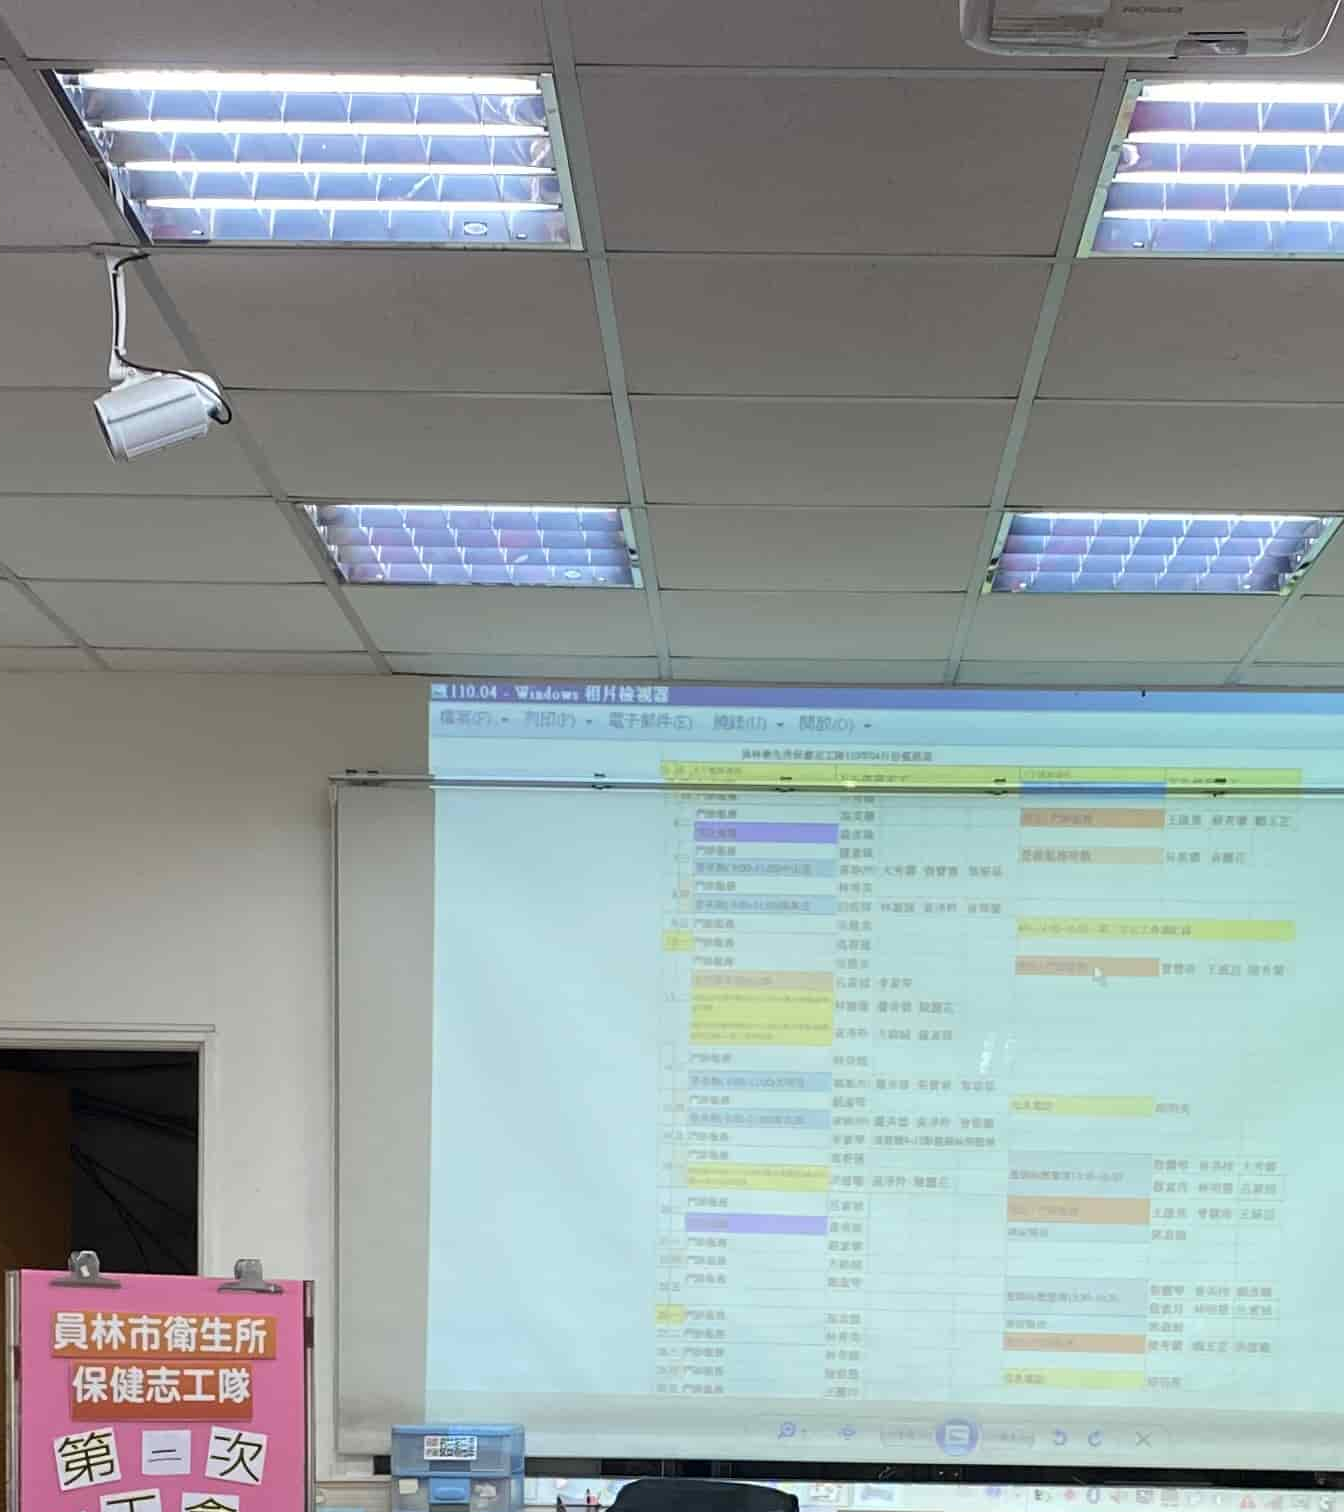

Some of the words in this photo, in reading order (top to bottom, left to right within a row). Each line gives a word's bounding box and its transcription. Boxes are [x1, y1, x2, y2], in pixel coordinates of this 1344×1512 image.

[514, 686, 580, 702] Windows
[52, 1311, 268, 1355] 員林市衛生所
[71, 1365, 252, 1405] 保健志工隊
